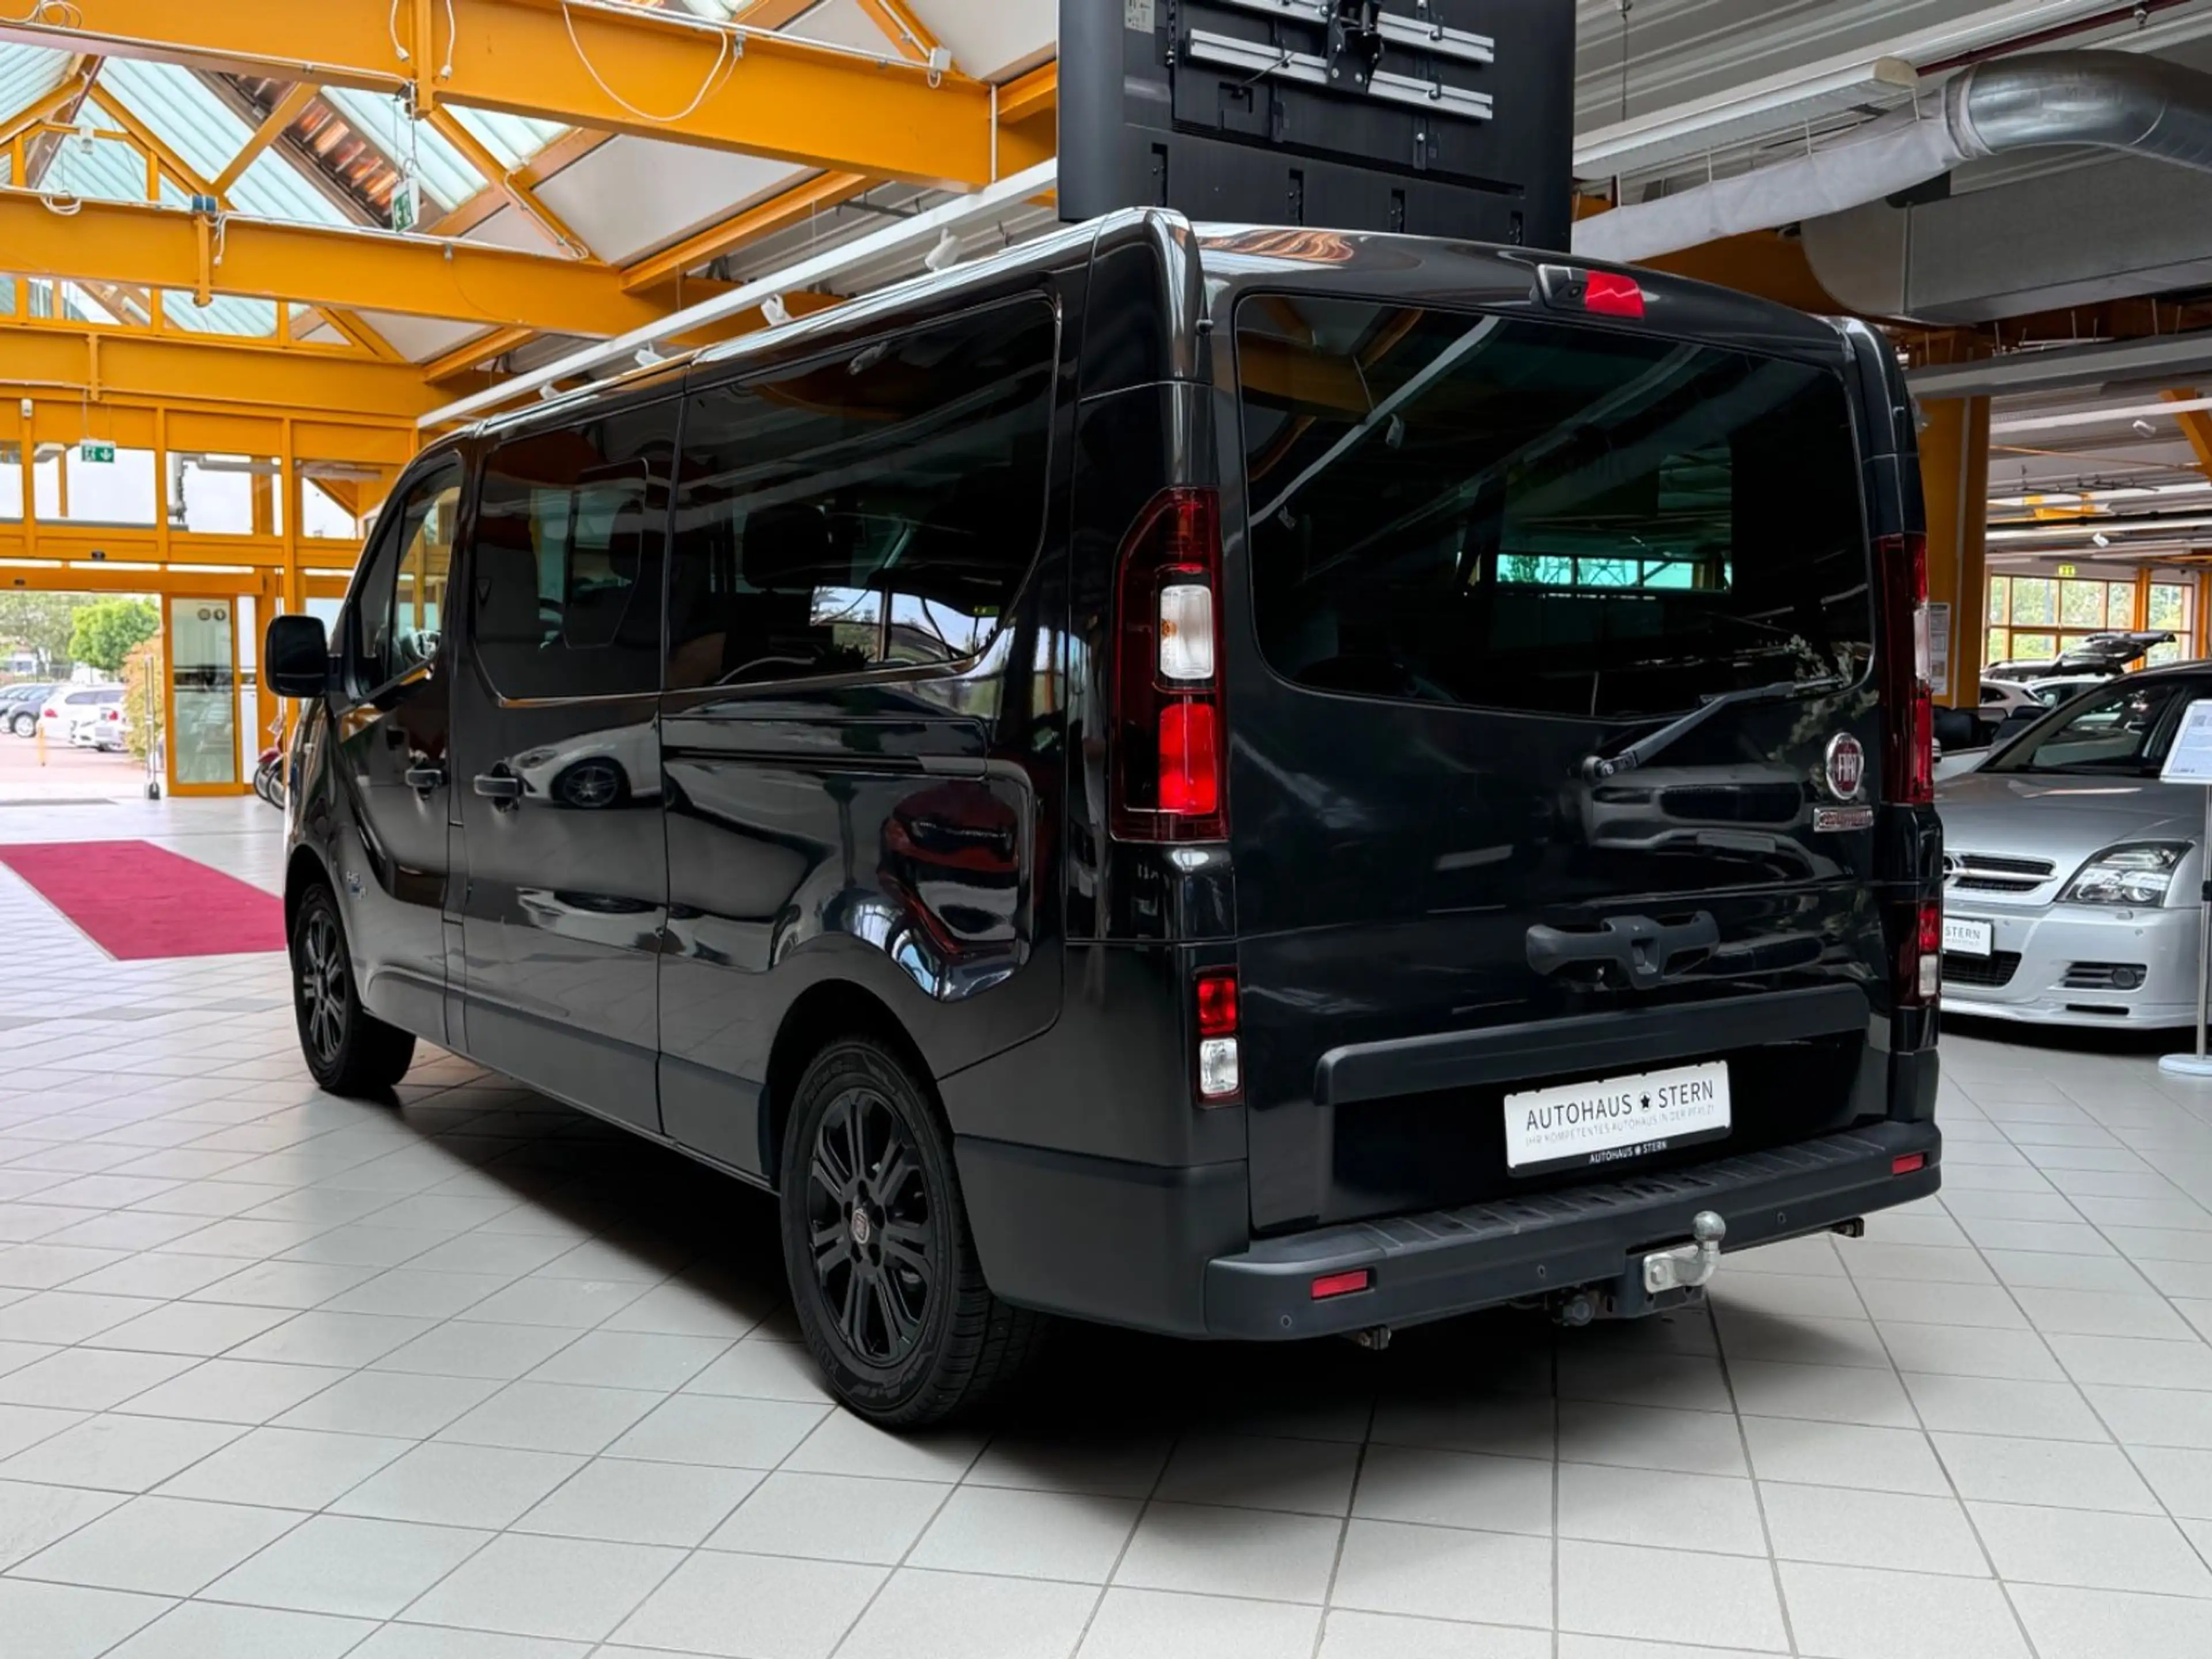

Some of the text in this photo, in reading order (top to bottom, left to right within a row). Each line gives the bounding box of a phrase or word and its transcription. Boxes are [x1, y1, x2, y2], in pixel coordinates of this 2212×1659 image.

[1837, 753, 1858, 782] FIAT
[1944, 926, 1981, 940] STERN
[1527, 1080, 1713, 1131] AUTOHAUS STERN
[1525, 1132, 1542, 1146] IHR
[1612, 1115, 1657, 1132] AUTOHAUS
[1589, 1141, 1668, 1164] AUTOHAUS STERN
